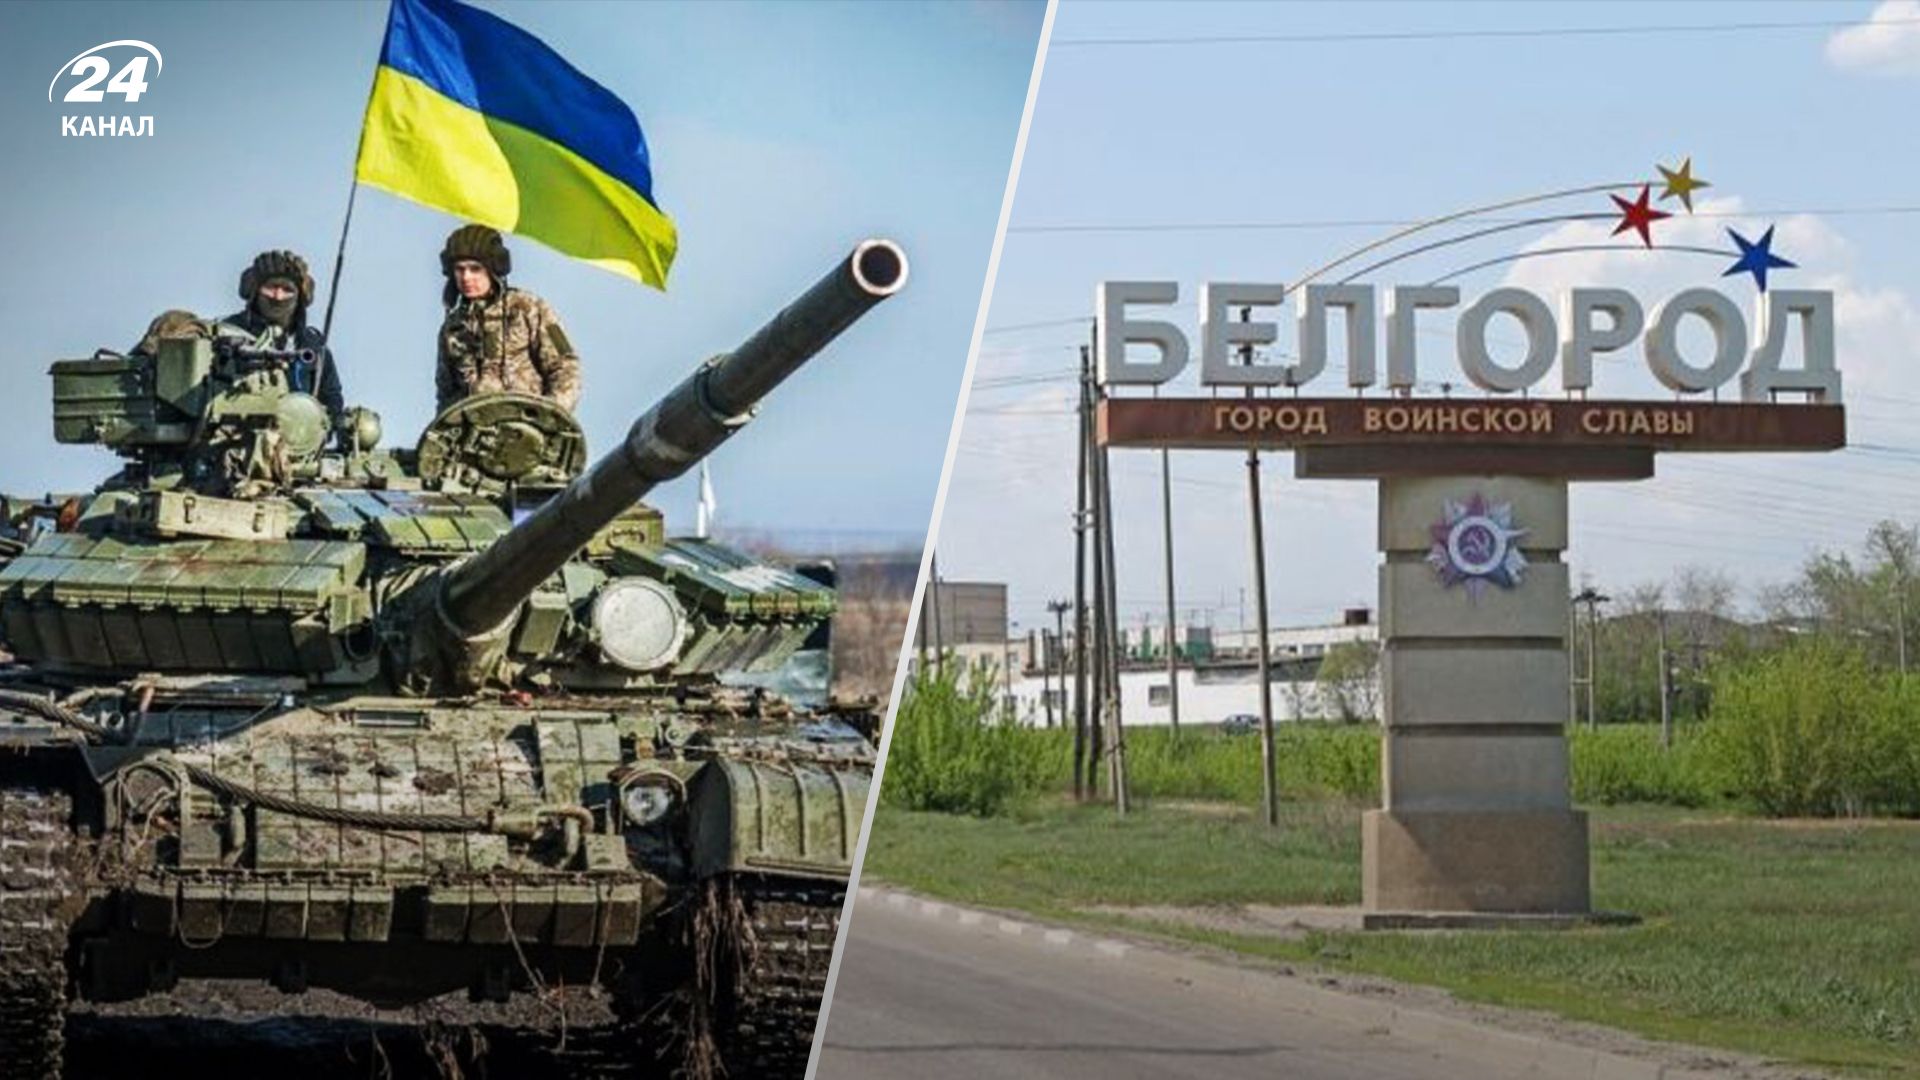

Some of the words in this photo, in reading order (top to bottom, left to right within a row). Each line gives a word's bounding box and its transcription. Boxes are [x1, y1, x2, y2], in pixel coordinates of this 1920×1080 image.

[1097, 281, 1841, 405] БЕЛГОРОД
[1214, 405, 1328, 434] ГОРОД
[1364, 404, 1553, 433] ВОИНСКОЙ
[1582, 408, 1695, 435] СЛАВЫ
